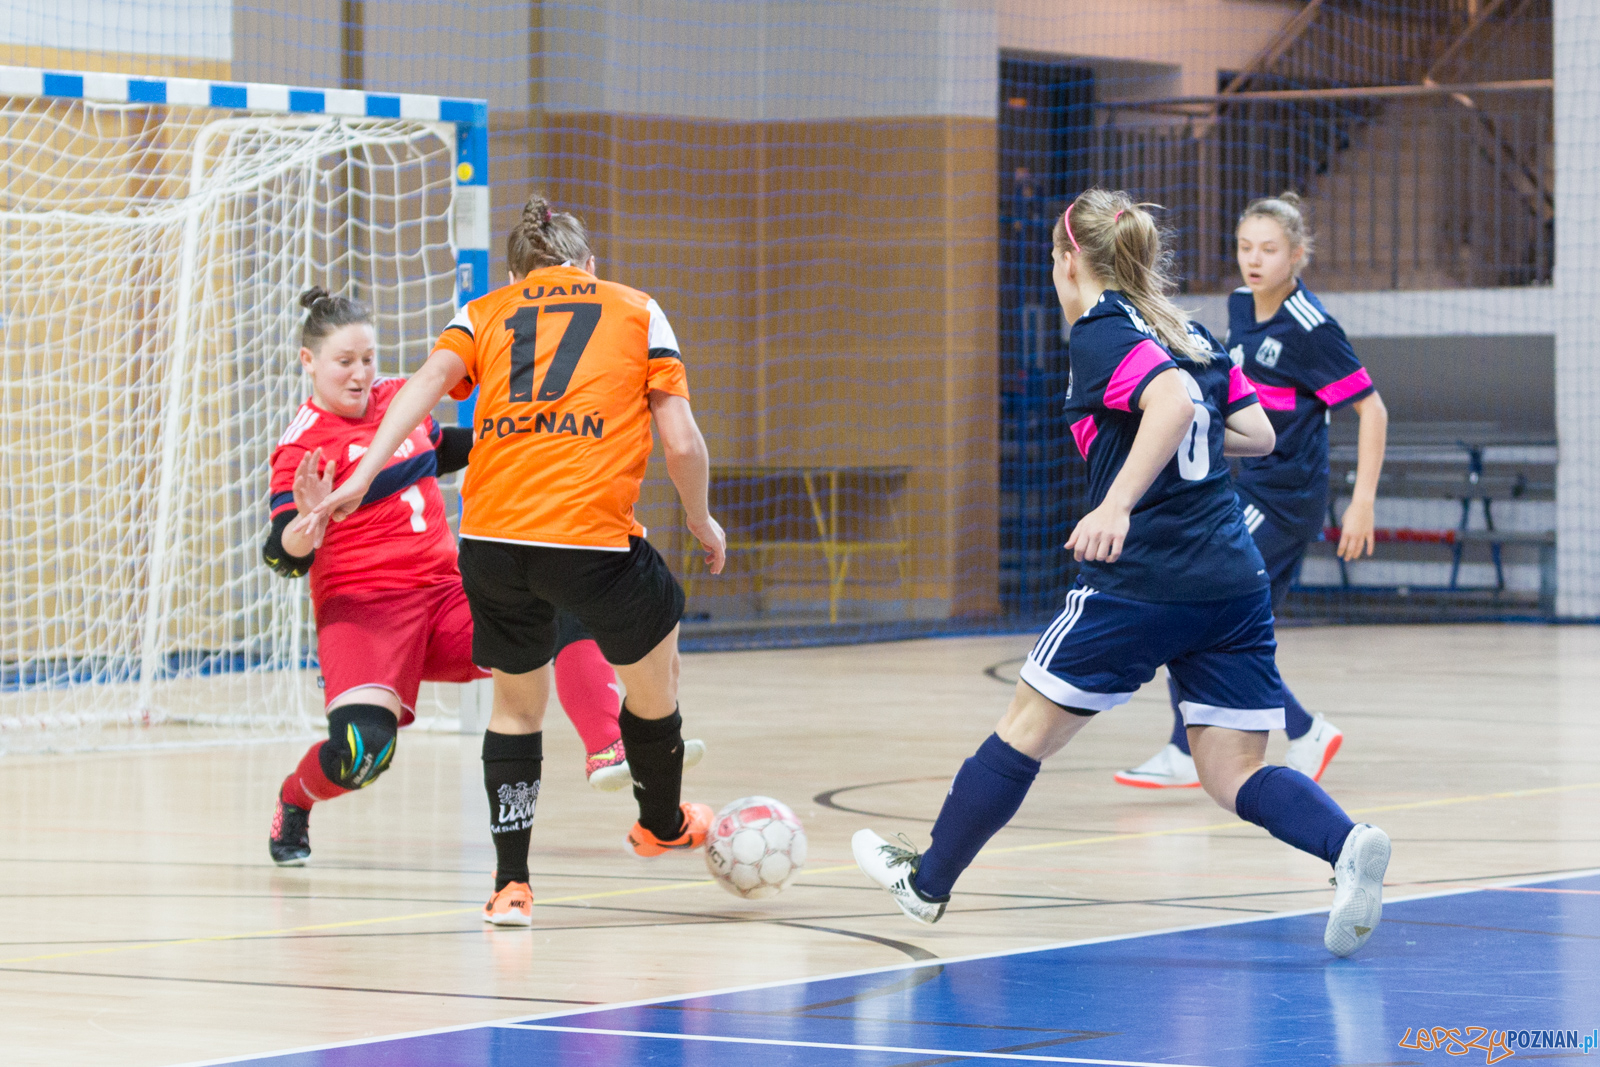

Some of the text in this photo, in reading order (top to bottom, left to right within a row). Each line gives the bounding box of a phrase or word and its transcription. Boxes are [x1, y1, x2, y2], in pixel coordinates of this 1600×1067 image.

[522, 283, 597, 300] UAM
[504, 302, 603, 403] 17
[479, 410, 605, 440] POZNAŃ
[400, 485, 428, 533] 1
[508, 899, 527, 909] NIKE
[888, 887, 911, 898] adidas
